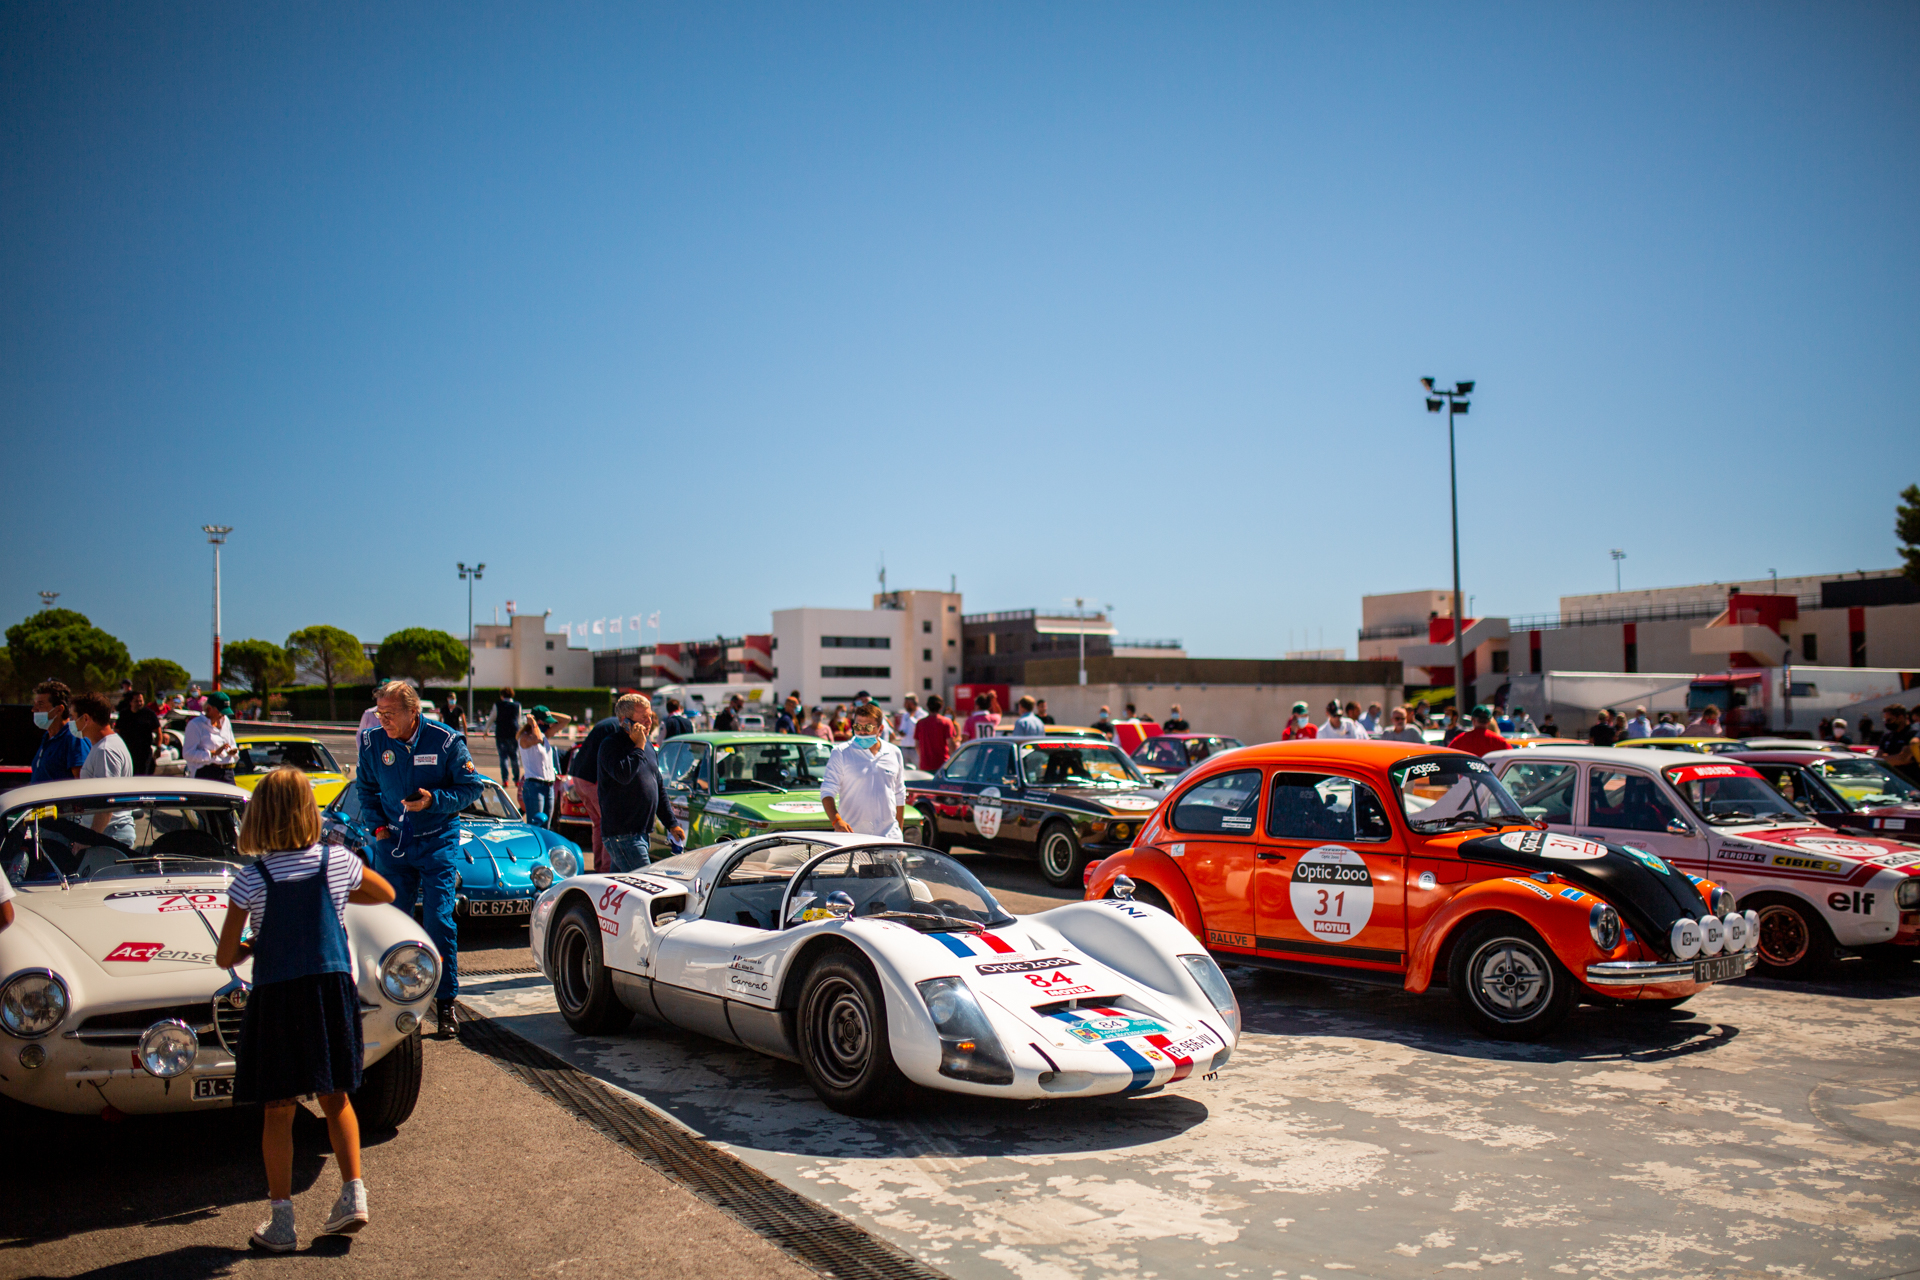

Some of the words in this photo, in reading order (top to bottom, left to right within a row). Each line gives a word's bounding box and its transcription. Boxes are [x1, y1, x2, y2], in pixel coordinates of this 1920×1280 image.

[1718, 851, 1756, 861] FERODO
[1297, 863, 1332, 882] Optic
[1335, 865, 1368, 882] 2000
[114, 889, 176, 898] Optic
[156, 894, 217, 906] 70
[599, 884, 630, 915] 84
[472, 902, 488, 915] CC
[491, 901, 514, 914] 675
[516, 900, 530, 913] ZR
[1313, 889, 1345, 917] 31
[1827, 891, 1875, 915] elf
[1315, 922, 1350, 934] MOTUL
[1210, 932, 1248, 946] RALLYE
[979, 963, 1029, 974] Optic
[731, 975, 761, 990] Carrera
[761, 981, 769, 991] 6
[1023, 970, 1074, 988] 84
[1047, 985, 1092, 997] MOTUL
[1098, 1020, 1123, 1030] 84
[1167, 1033, 1216, 1058] FP-956-VV
